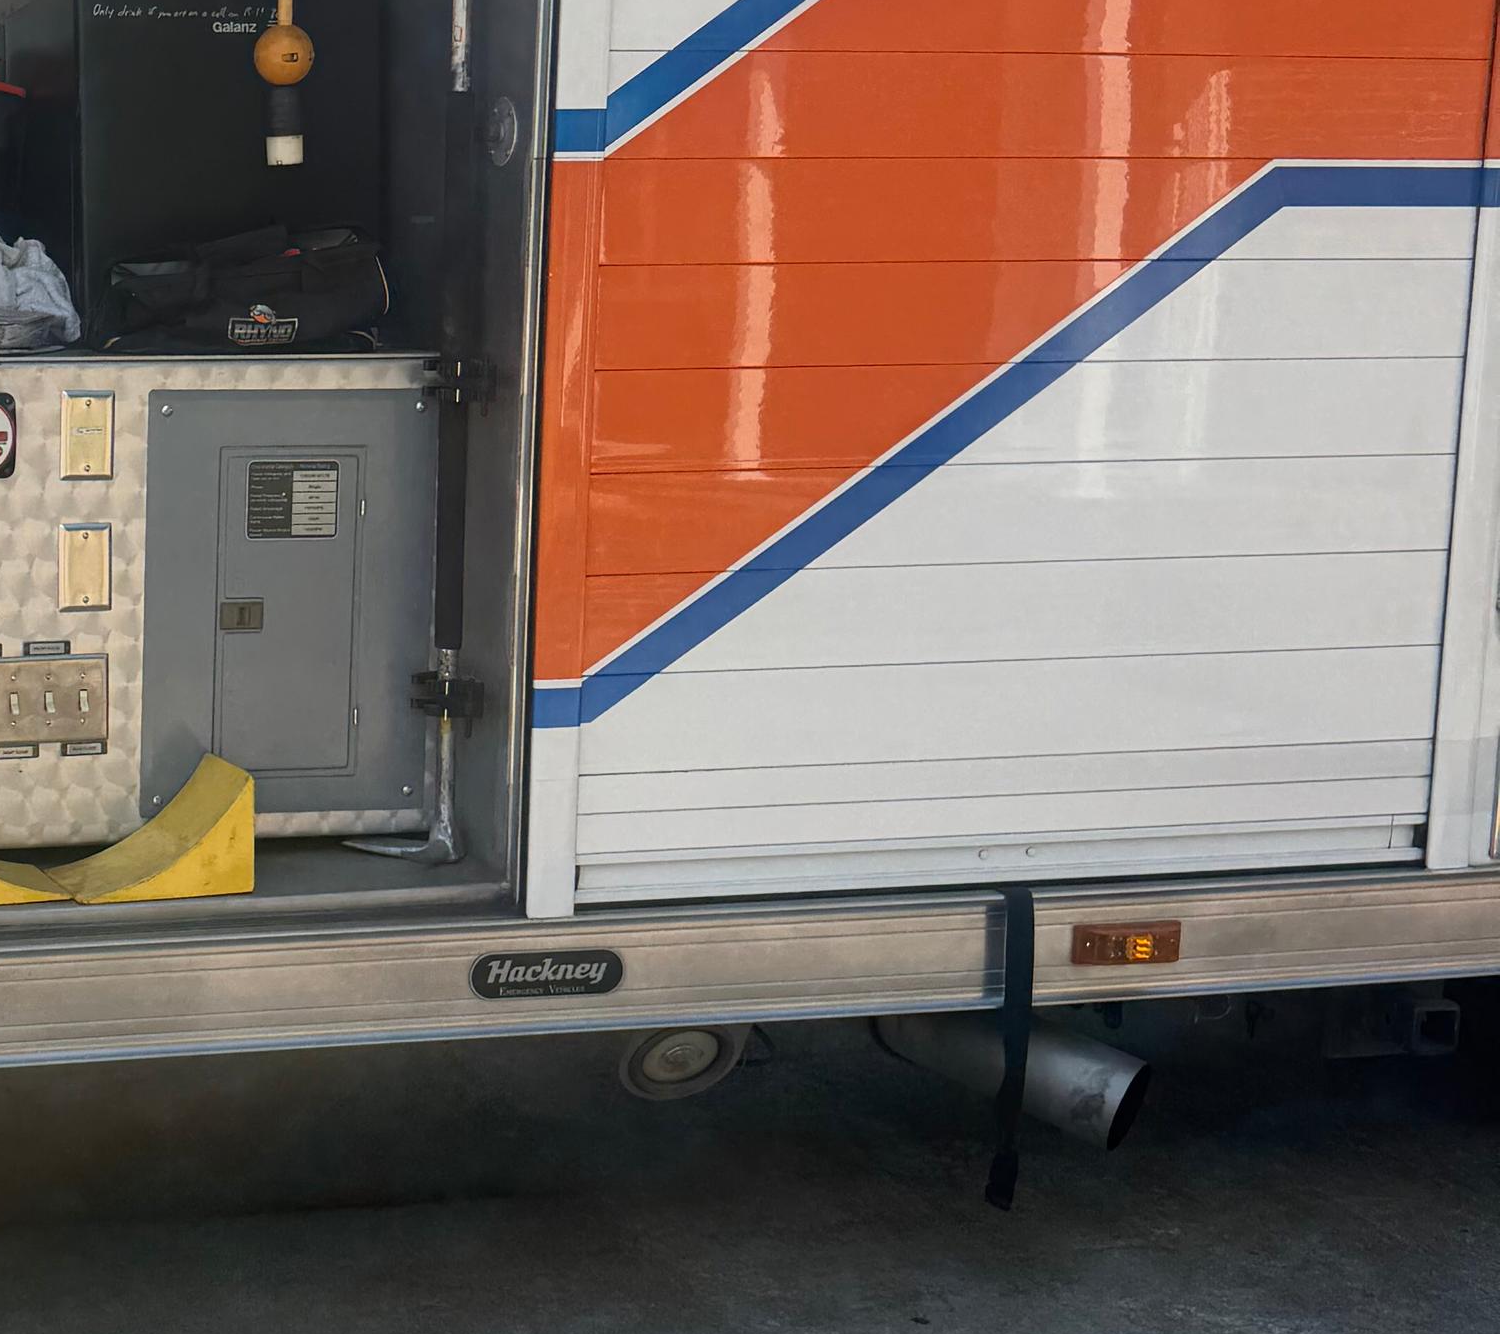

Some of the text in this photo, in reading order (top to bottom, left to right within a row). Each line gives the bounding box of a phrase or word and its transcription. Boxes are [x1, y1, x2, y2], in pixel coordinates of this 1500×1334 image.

[93, 3, 115, 19] Only
[212, 21, 257, 33] Galanz
[486, 958, 608, 985] Hackney
